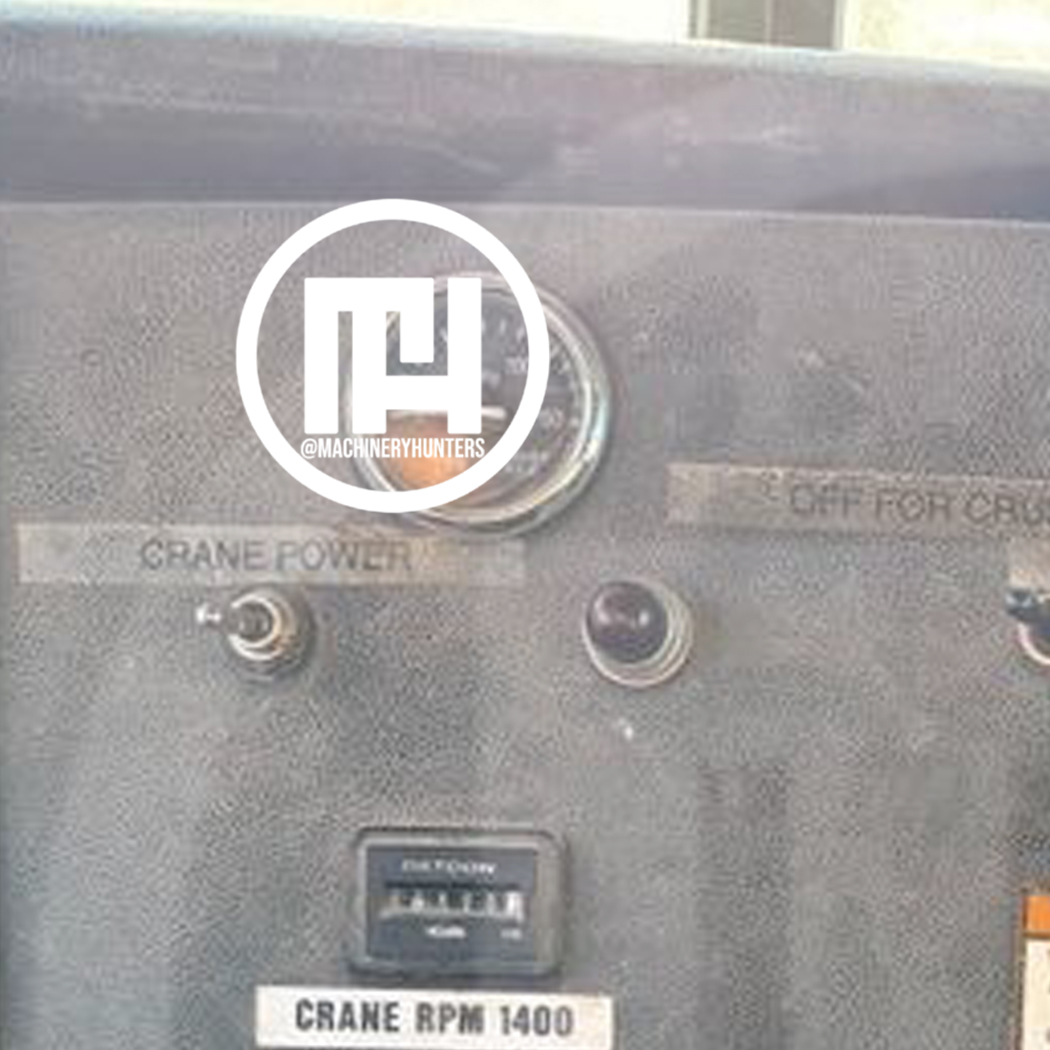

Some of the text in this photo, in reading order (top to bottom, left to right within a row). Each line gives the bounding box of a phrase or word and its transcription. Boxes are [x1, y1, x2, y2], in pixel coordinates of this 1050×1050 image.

[790, 485, 862, 519] OFF
[875, 489, 951, 521] FOR
[140, 538, 412, 571] CRANE POWER
[295, 999, 574, 1037] CRANE RPM 1400
